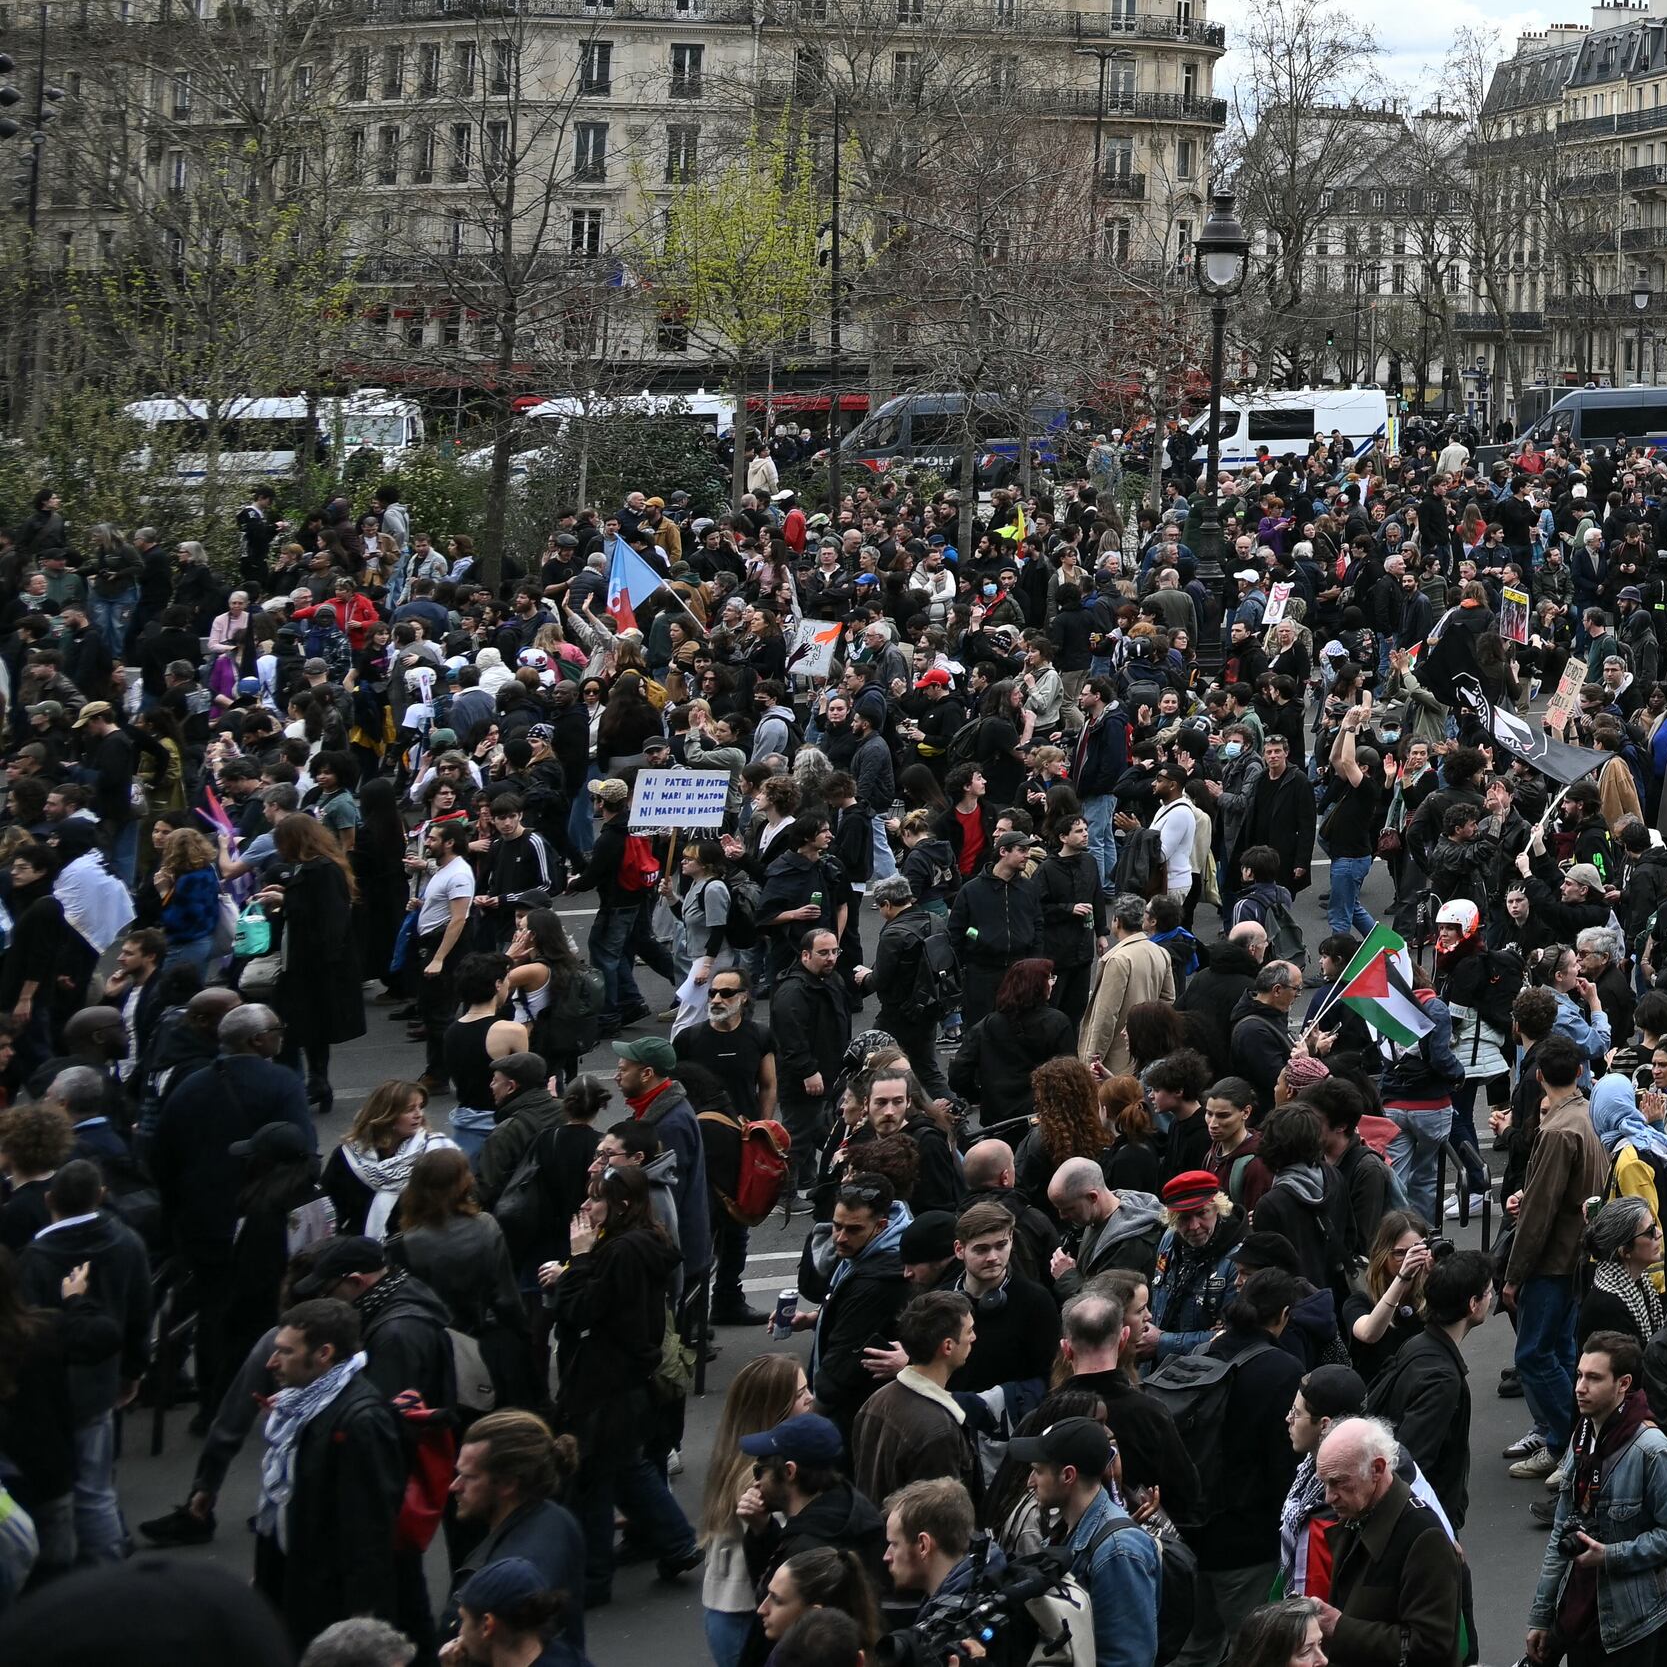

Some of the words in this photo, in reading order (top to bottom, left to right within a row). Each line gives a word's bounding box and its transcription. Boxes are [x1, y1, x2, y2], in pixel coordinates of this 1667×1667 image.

[645, 778, 658, 786] NI
[664, 778, 693, 787] PATRIE
[695, 778, 704, 787] NI
[642, 791, 655, 800] NI
[661, 792, 682, 800] MARI
[697, 792, 724, 800] MATON
[640, 807, 652, 817] NI
[654, 807, 686, 815] MARINE
[688, 807, 697, 815] NI
[697, 806, 725, 815] MACRON
